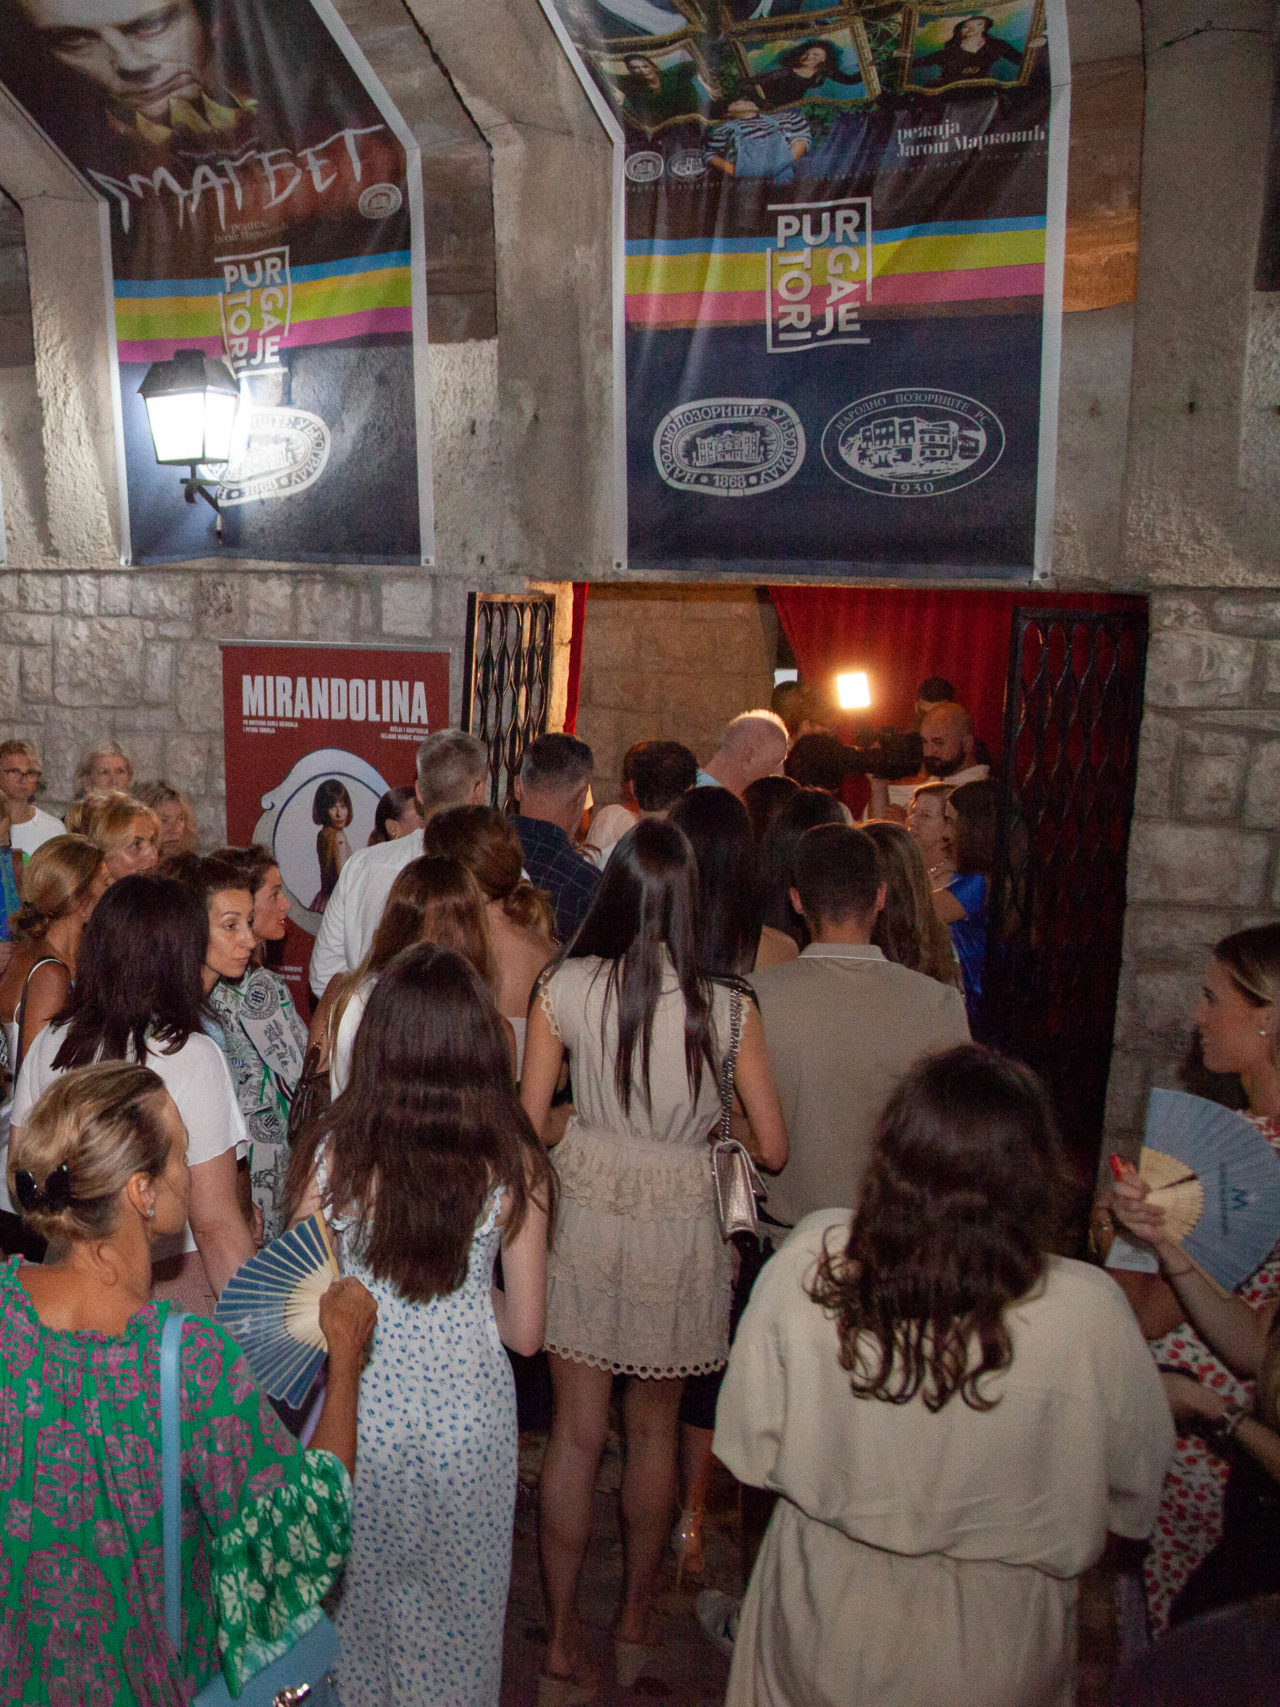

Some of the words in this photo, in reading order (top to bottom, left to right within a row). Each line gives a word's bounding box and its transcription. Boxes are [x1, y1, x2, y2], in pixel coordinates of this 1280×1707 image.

[777, 208, 861, 249] PUR
[223, 257, 282, 292] PUR
[890, 482, 933, 494] 1930
[242, 675, 428, 724] MIRANDOLINA
